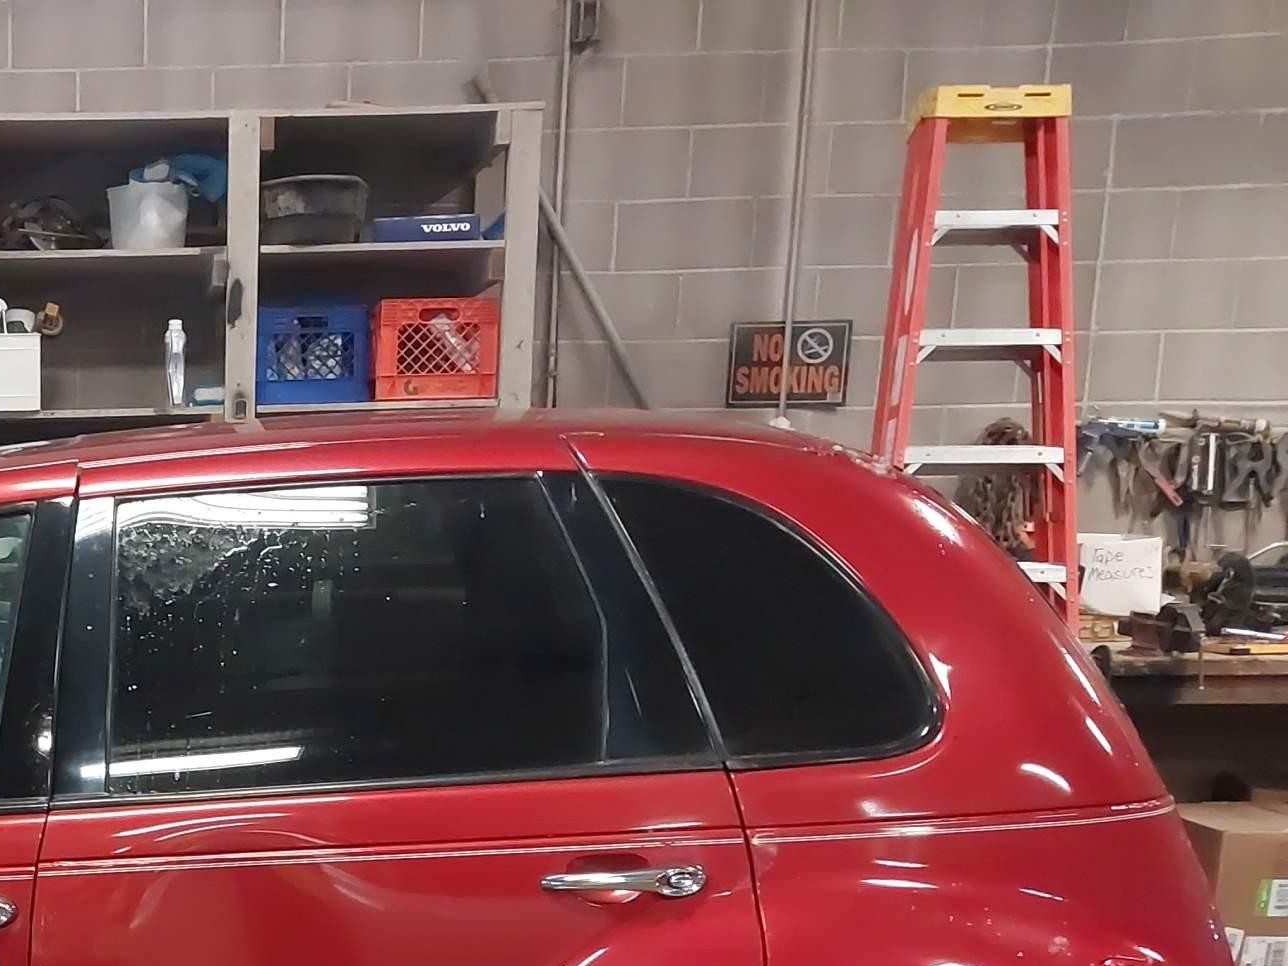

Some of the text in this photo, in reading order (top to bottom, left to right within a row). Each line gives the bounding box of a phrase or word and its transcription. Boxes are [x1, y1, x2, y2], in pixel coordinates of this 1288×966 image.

[421, 222, 471, 233] VOLVO
[752, 333, 785, 362] NO
[734, 365, 841, 394] SMOKING
[1094, 547, 1124, 565] Tape
